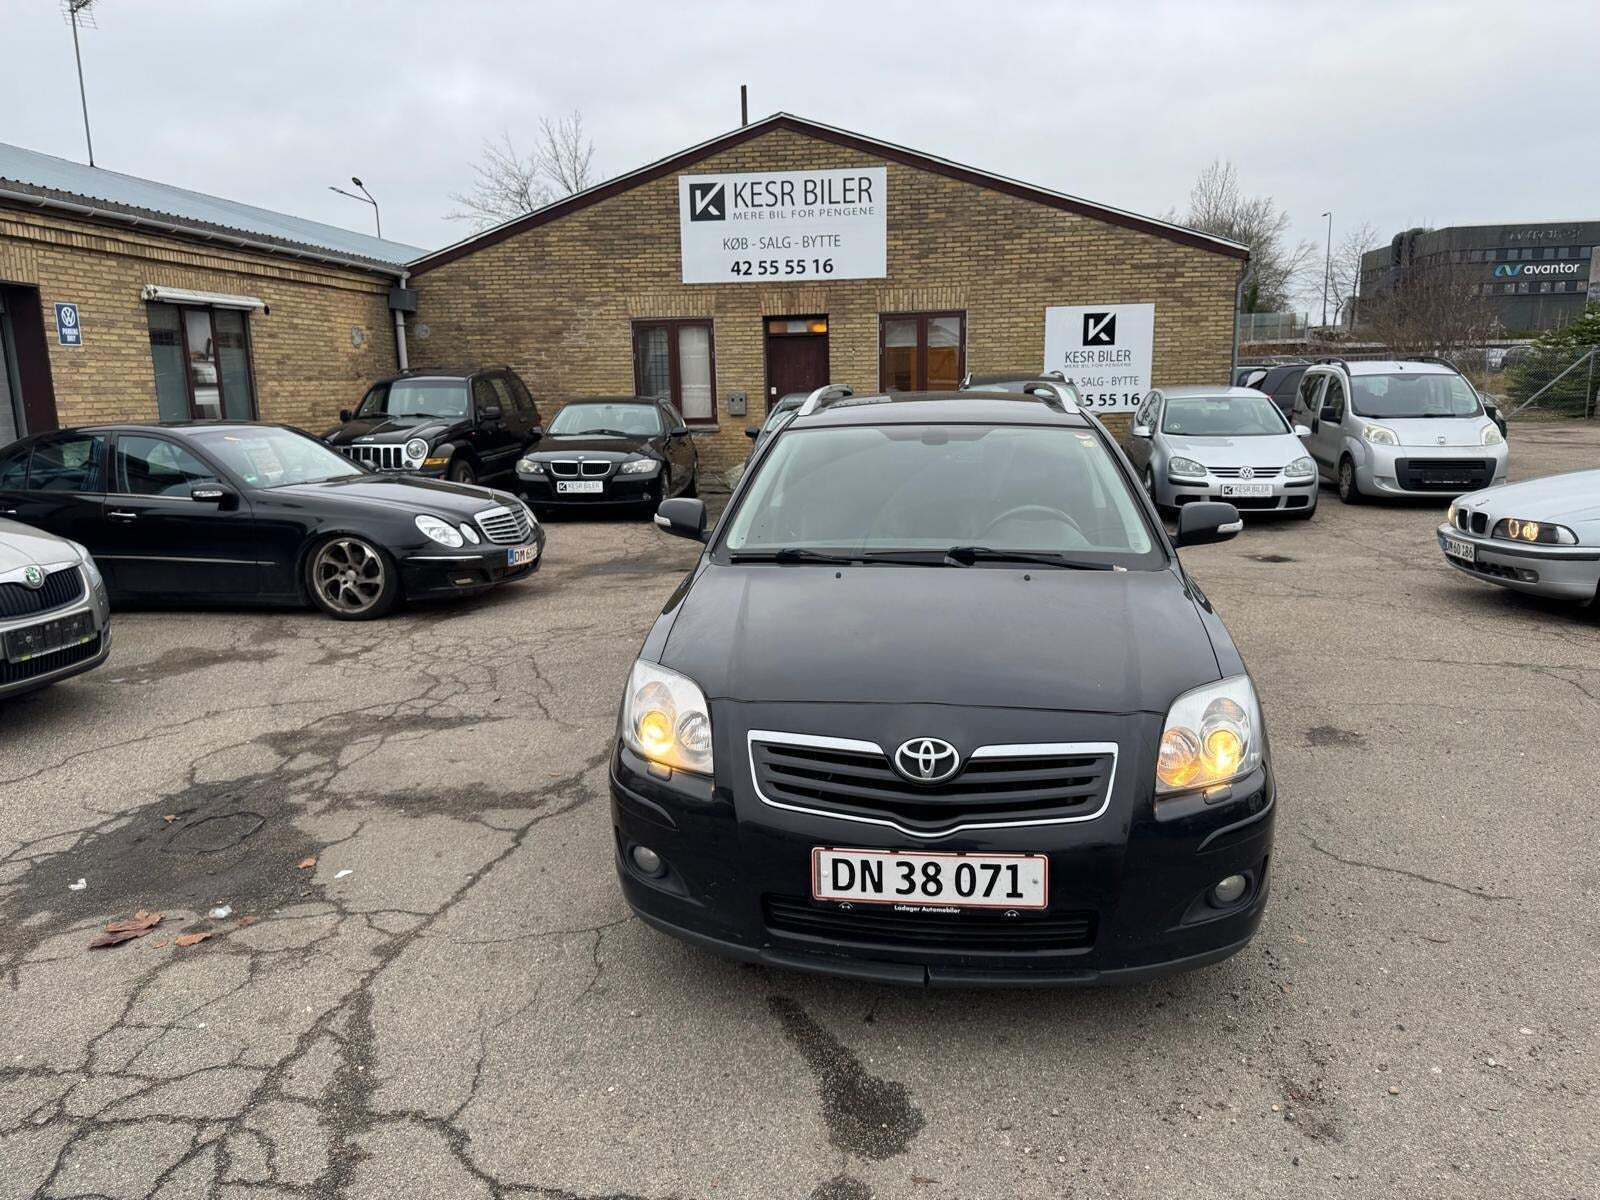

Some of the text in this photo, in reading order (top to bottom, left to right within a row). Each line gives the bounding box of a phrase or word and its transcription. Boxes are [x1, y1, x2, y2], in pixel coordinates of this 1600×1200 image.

[733, 176, 873, 209] KESR BILER
[733, 206, 875, 221] MERE BIL FOR PENGENE
[723, 236, 749, 251] KØB
[759, 236, 792, 250] SALG
[802, 234, 842, 249] BYTTE
[730, 258, 835, 276] 42 55 55 16
[1523, 262, 1580, 275] avantor
[1064, 349, 1132, 364] KESR BILER
[1081, 376, 1104, 388] SALG
[1111, 375, 1140, 386] BYTTE
[1081, 392, 1141, 407] 5 55 16
[831, 858, 1024, 899] DN 38 071
